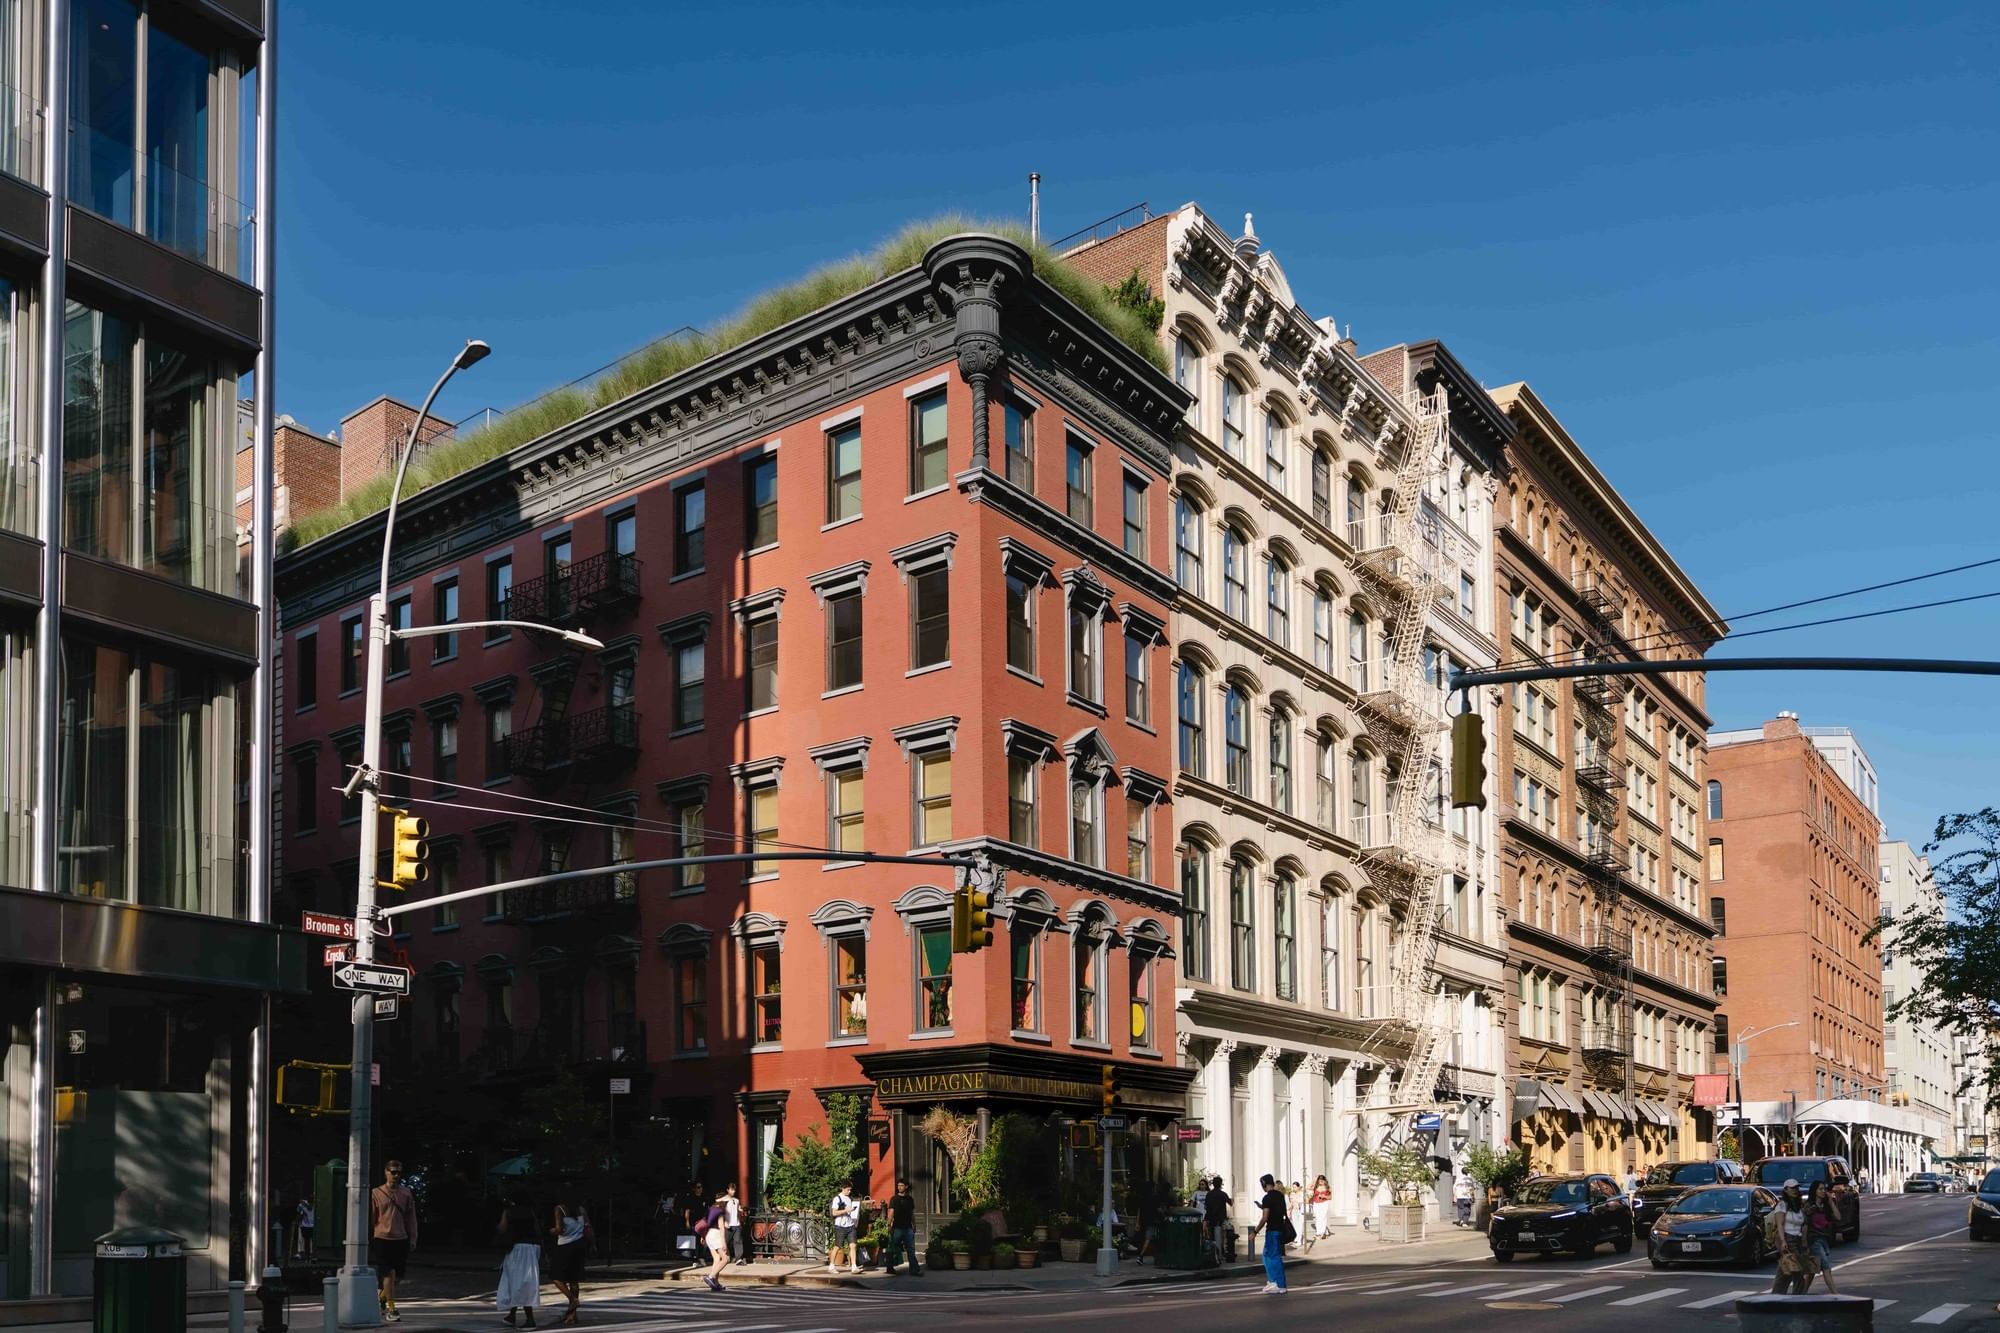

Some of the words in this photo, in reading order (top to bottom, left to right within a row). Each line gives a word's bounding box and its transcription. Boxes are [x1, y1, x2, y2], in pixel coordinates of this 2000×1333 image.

[305, 917, 340, 934] Broome
[344, 923, 353, 937] St
[344, 970, 366, 982] ONE
[378, 974, 402, 986] WAY
[378, 1000, 394, 1011] WAY
[880, 1072, 984, 1095] CHAMPAGNE
[988, 1074, 1013, 1090] FOR
[1017, 1076, 1041, 1092] THE
[1047, 1079, 1090, 1097] PEOPLE
